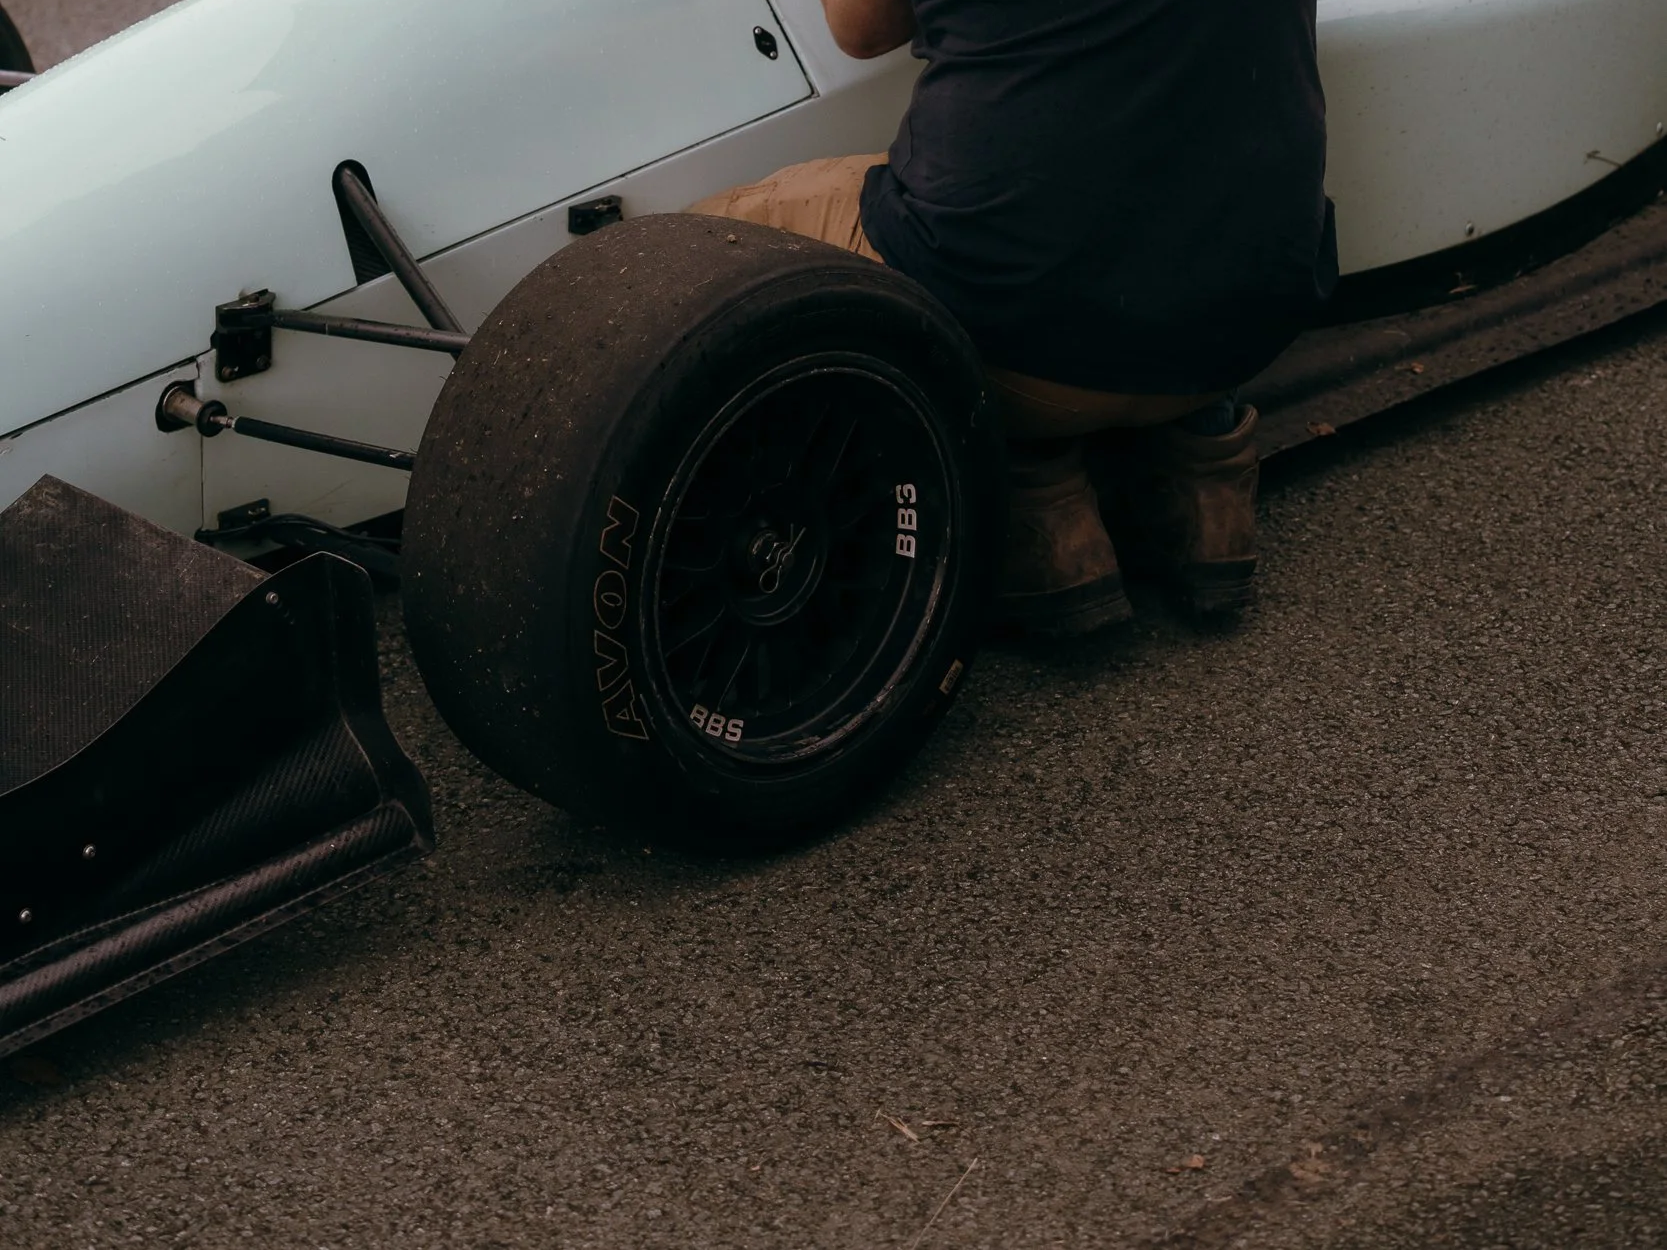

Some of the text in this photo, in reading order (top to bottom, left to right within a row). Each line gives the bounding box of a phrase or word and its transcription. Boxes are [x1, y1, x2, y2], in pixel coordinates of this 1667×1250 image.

[896, 482, 918, 559] BBS
[593, 494, 650, 741] AVON
[688, 703, 745, 743] BBS
